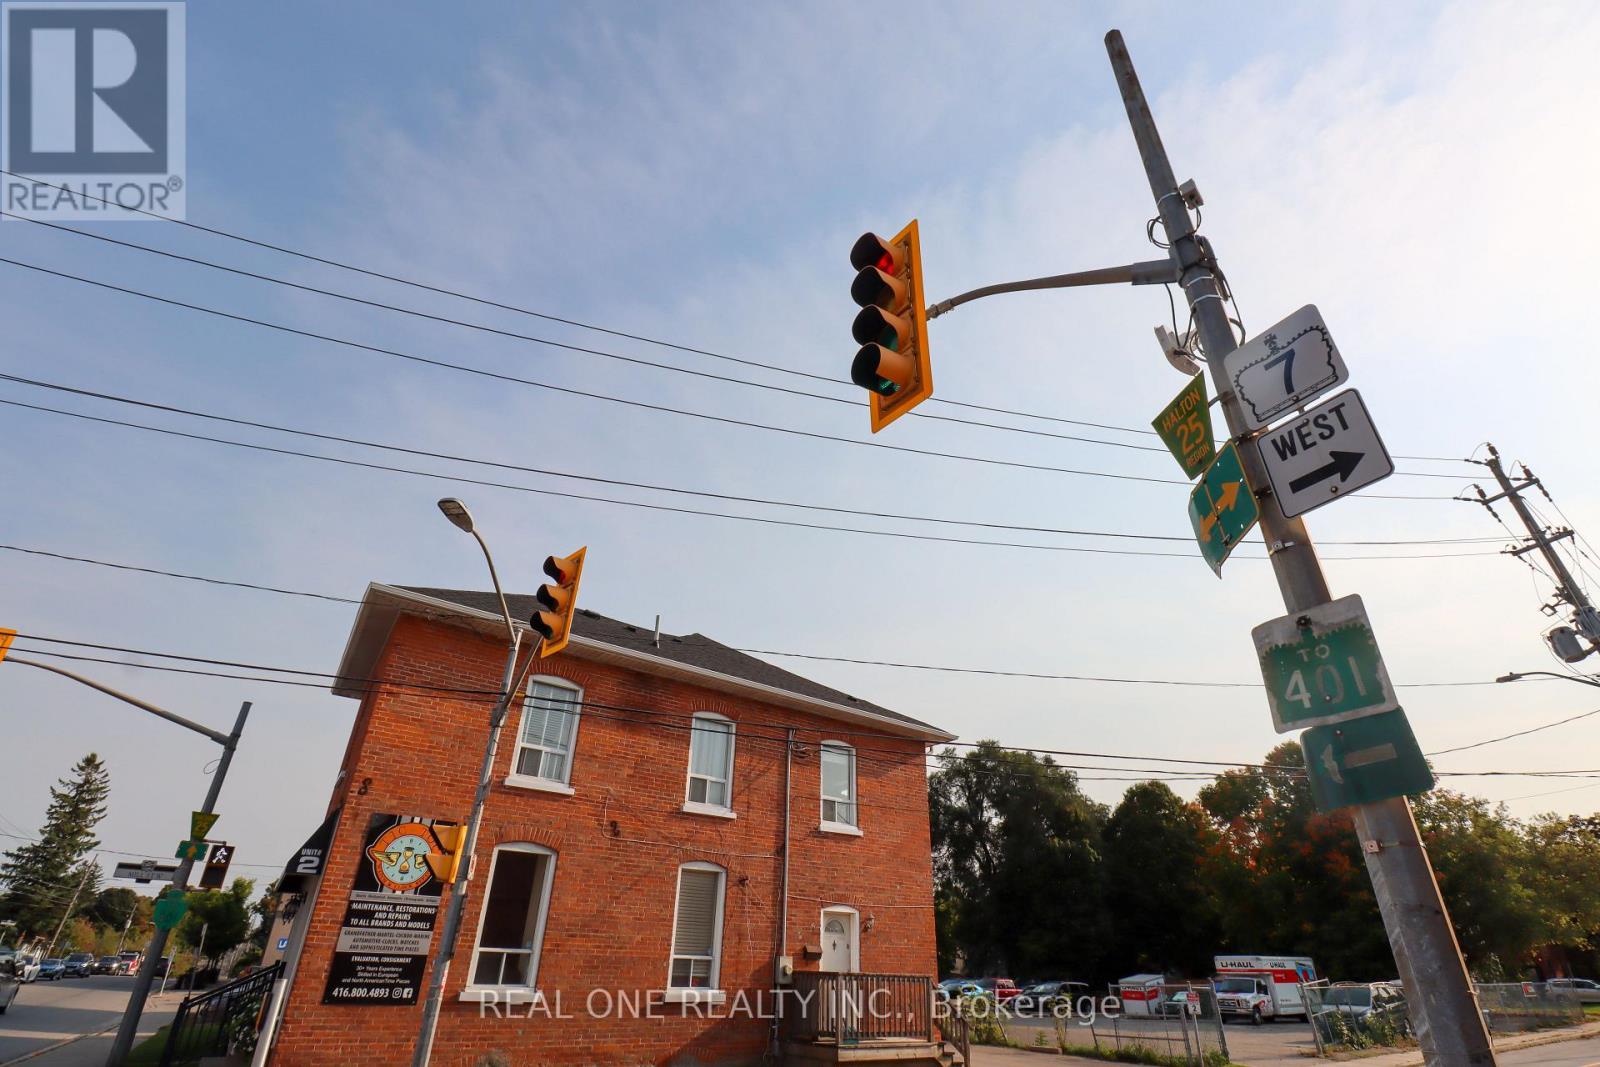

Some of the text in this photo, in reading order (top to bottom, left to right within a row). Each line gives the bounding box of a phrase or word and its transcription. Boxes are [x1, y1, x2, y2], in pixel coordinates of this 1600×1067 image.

[1264, 348, 1295, 395] 7
[1161, 389, 1201, 432] HALTON
[1176, 412, 1205, 454] 25
[1271, 402, 1349, 461] WEST
[1186, 442, 1210, 469] REGION
[1296, 644, 1329, 662] TO
[1285, 656, 1367, 708] 401
[296, 855, 320, 874] 2
[351, 902, 436, 914] MAINTENANCE, RESTORATIONS
[387, 912, 411, 920] REPAIRS
[350, 918, 359, 926] TO
[370, 919, 394, 928] BRANDS
[394, 920, 407, 928] AND
[407, 921, 431, 930] MODELS
[332, 987, 389, 998] 416.800.4893
